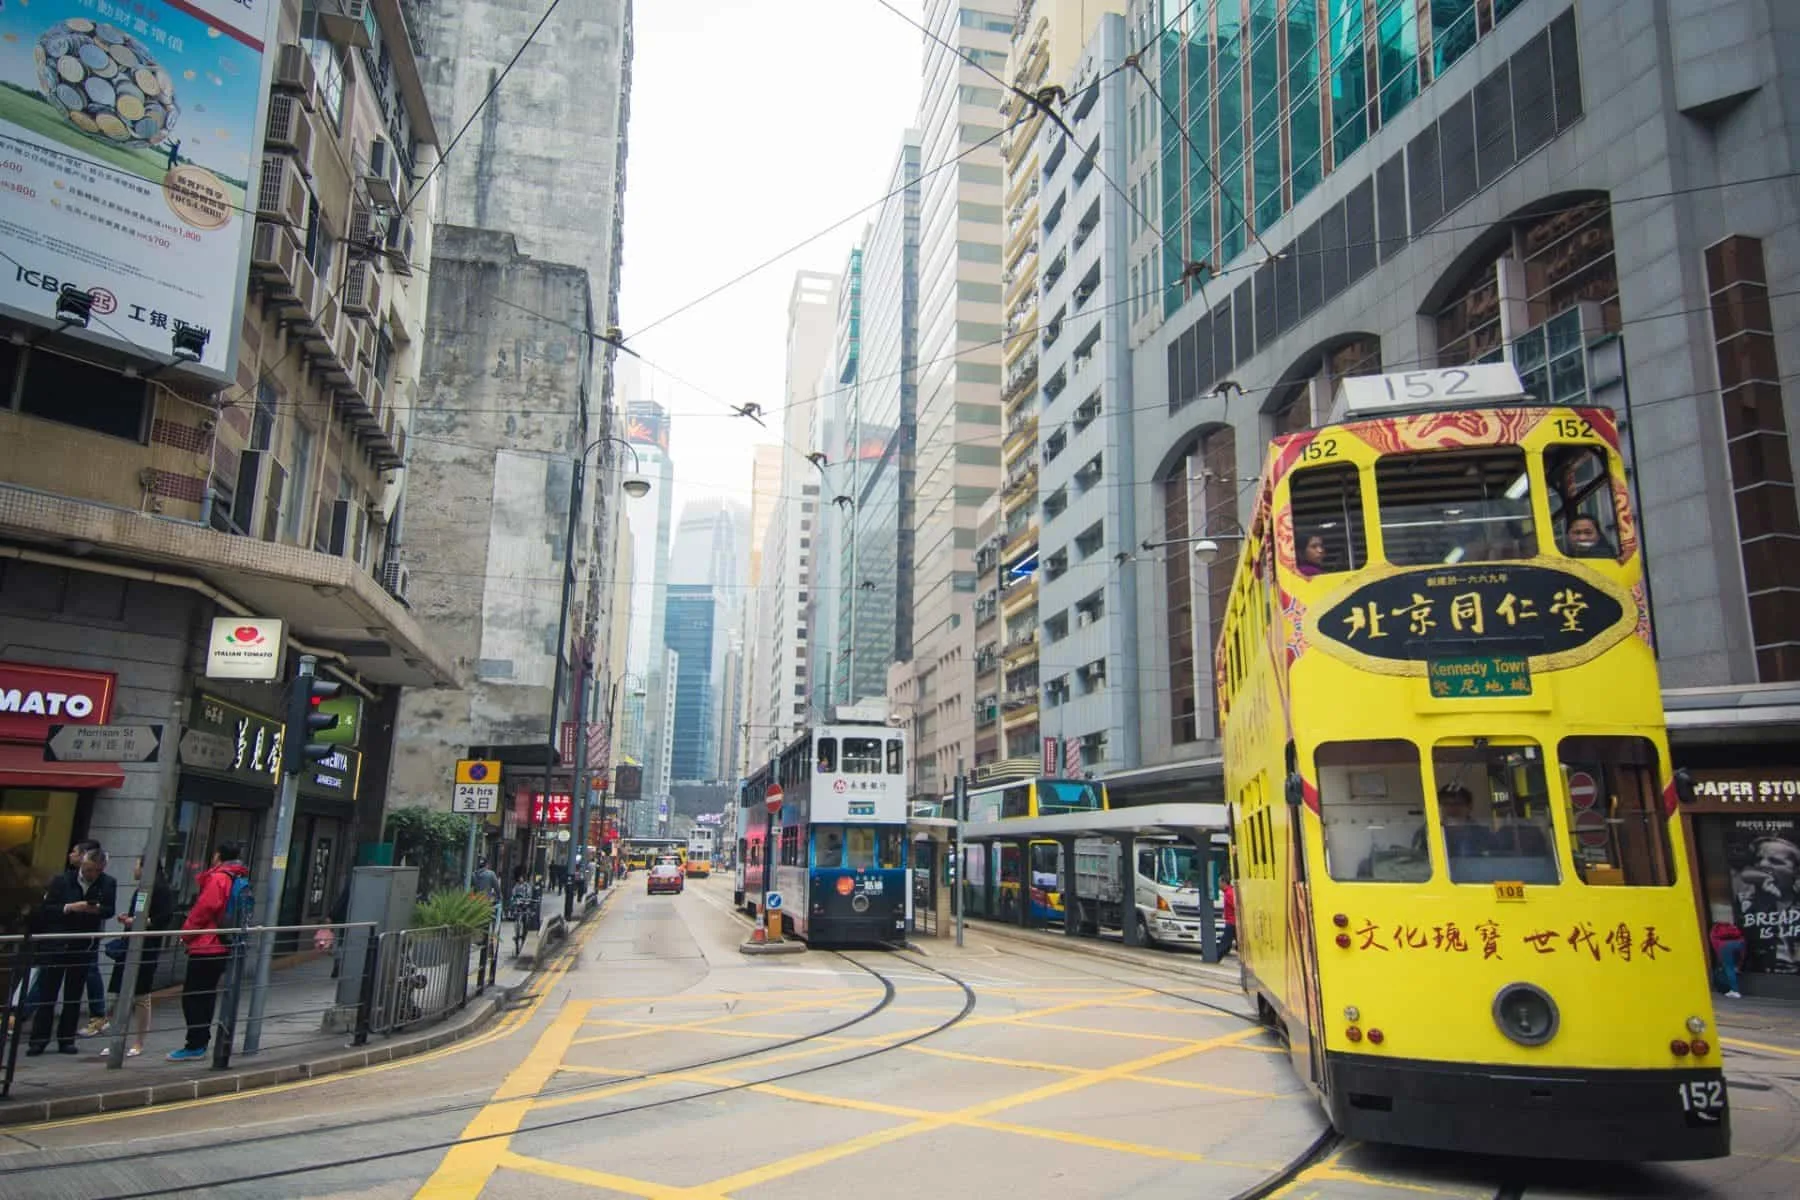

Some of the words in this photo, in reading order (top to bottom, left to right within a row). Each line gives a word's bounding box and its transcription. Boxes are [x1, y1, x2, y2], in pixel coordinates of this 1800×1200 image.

[1384, 368, 1475, 400] 152
[1553, 418, 1594, 438] 152
[1301, 439, 1337, 461] 152
[1342, 588, 1590, 640] 北京同仁堂
[1429, 660, 1488, 678] Kennedy
[123, 728, 134, 738] St
[460, 786, 476, 796] 24
[477, 786, 494, 796] hrs
[1693, 781, 1753, 796] PAPER
[463, 797, 490, 811] 全日
[1497, 886, 1524, 898] 108
[1743, 910, 1800, 928] BREAD
[1355, 919, 1504, 961] 文化瑰寶
[1760, 927, 1775, 939] IS
[1679, 1080, 1725, 1111] 152
